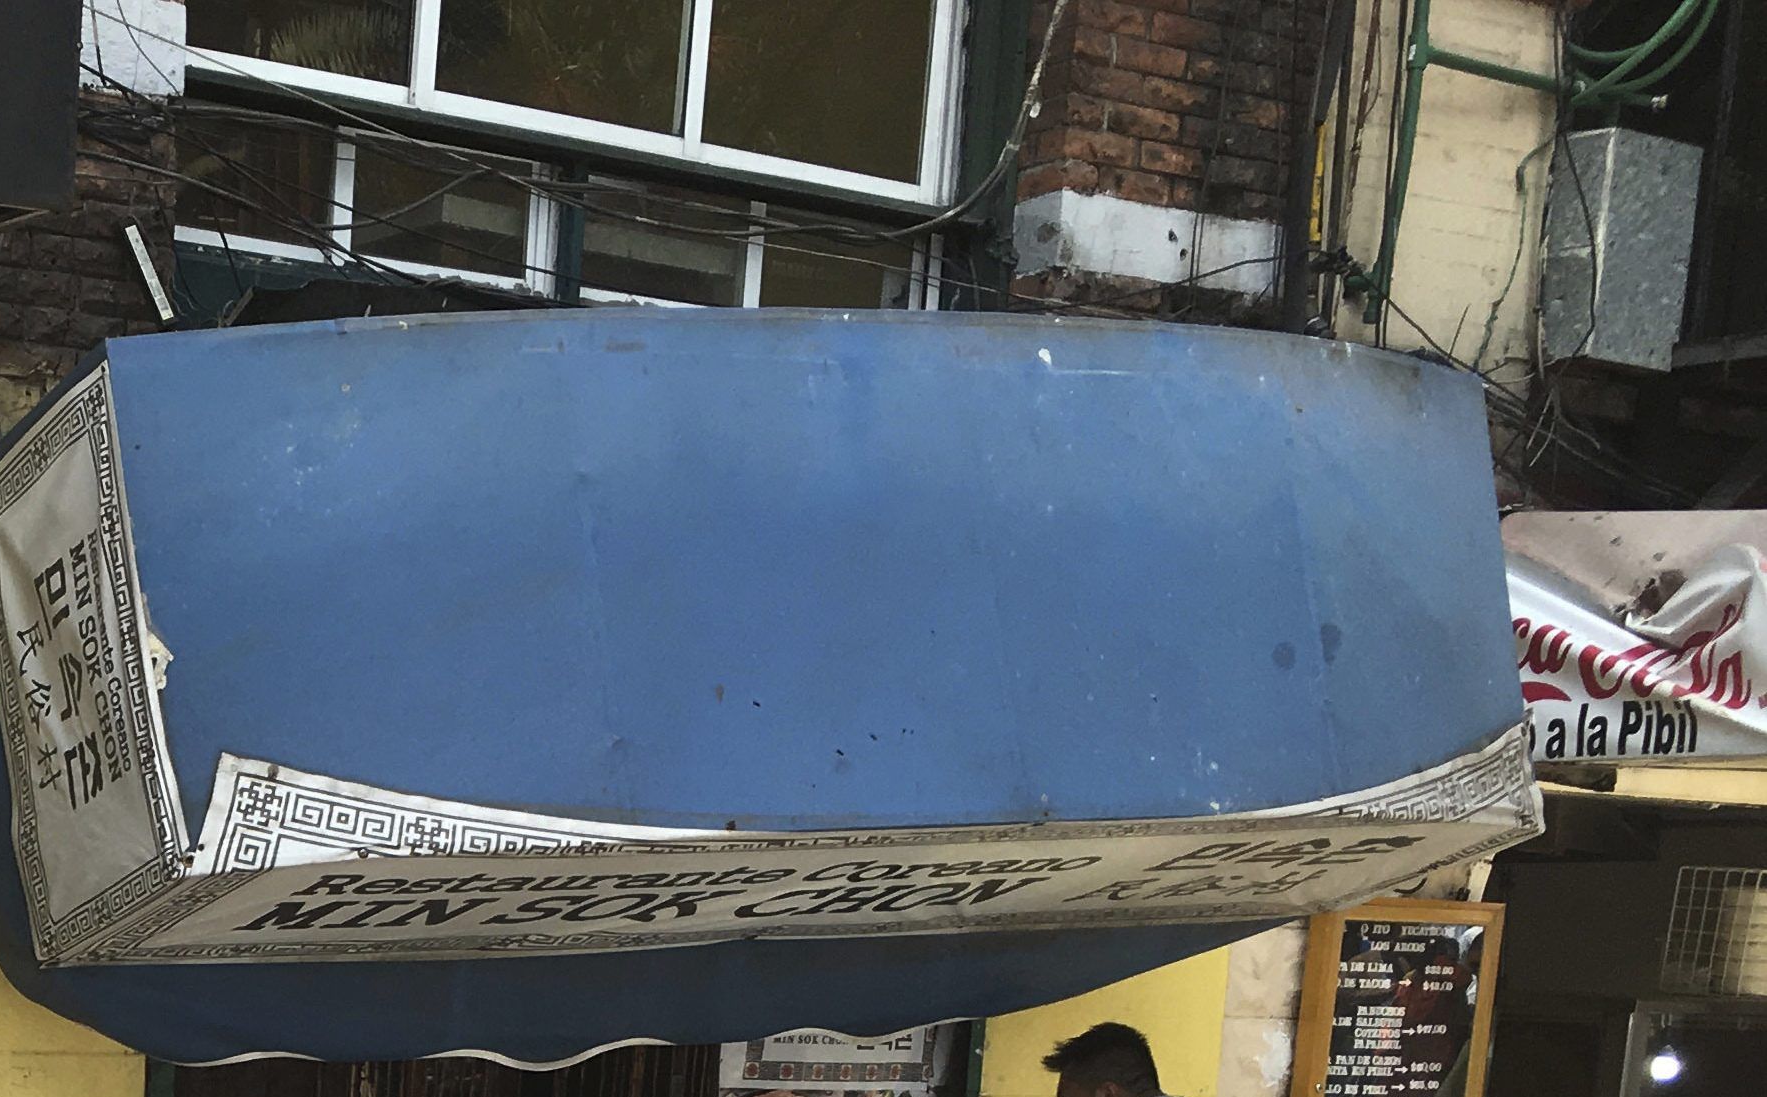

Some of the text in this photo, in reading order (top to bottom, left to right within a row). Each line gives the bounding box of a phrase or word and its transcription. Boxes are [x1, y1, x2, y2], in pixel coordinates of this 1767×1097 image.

[69, 539, 123, 784] MIN SOK CHON
[88, 529, 133, 773] Restaurante Coreano
[1545, 717, 1566, 760] a
[1575, 702, 1609, 758] la
[1617, 699, 1699, 756] Pibil
[289, 855, 1103, 898] Restaurante Coreano
[230, 877, 1053, 932] MIN SOK CHON
[1359, 979, 1392, 989] TACOS
[1367, 961, 1394, 973] LIMA
[797, 1034, 819, 1045] SOK
[1335, 1054, 1355, 1065] PAN
